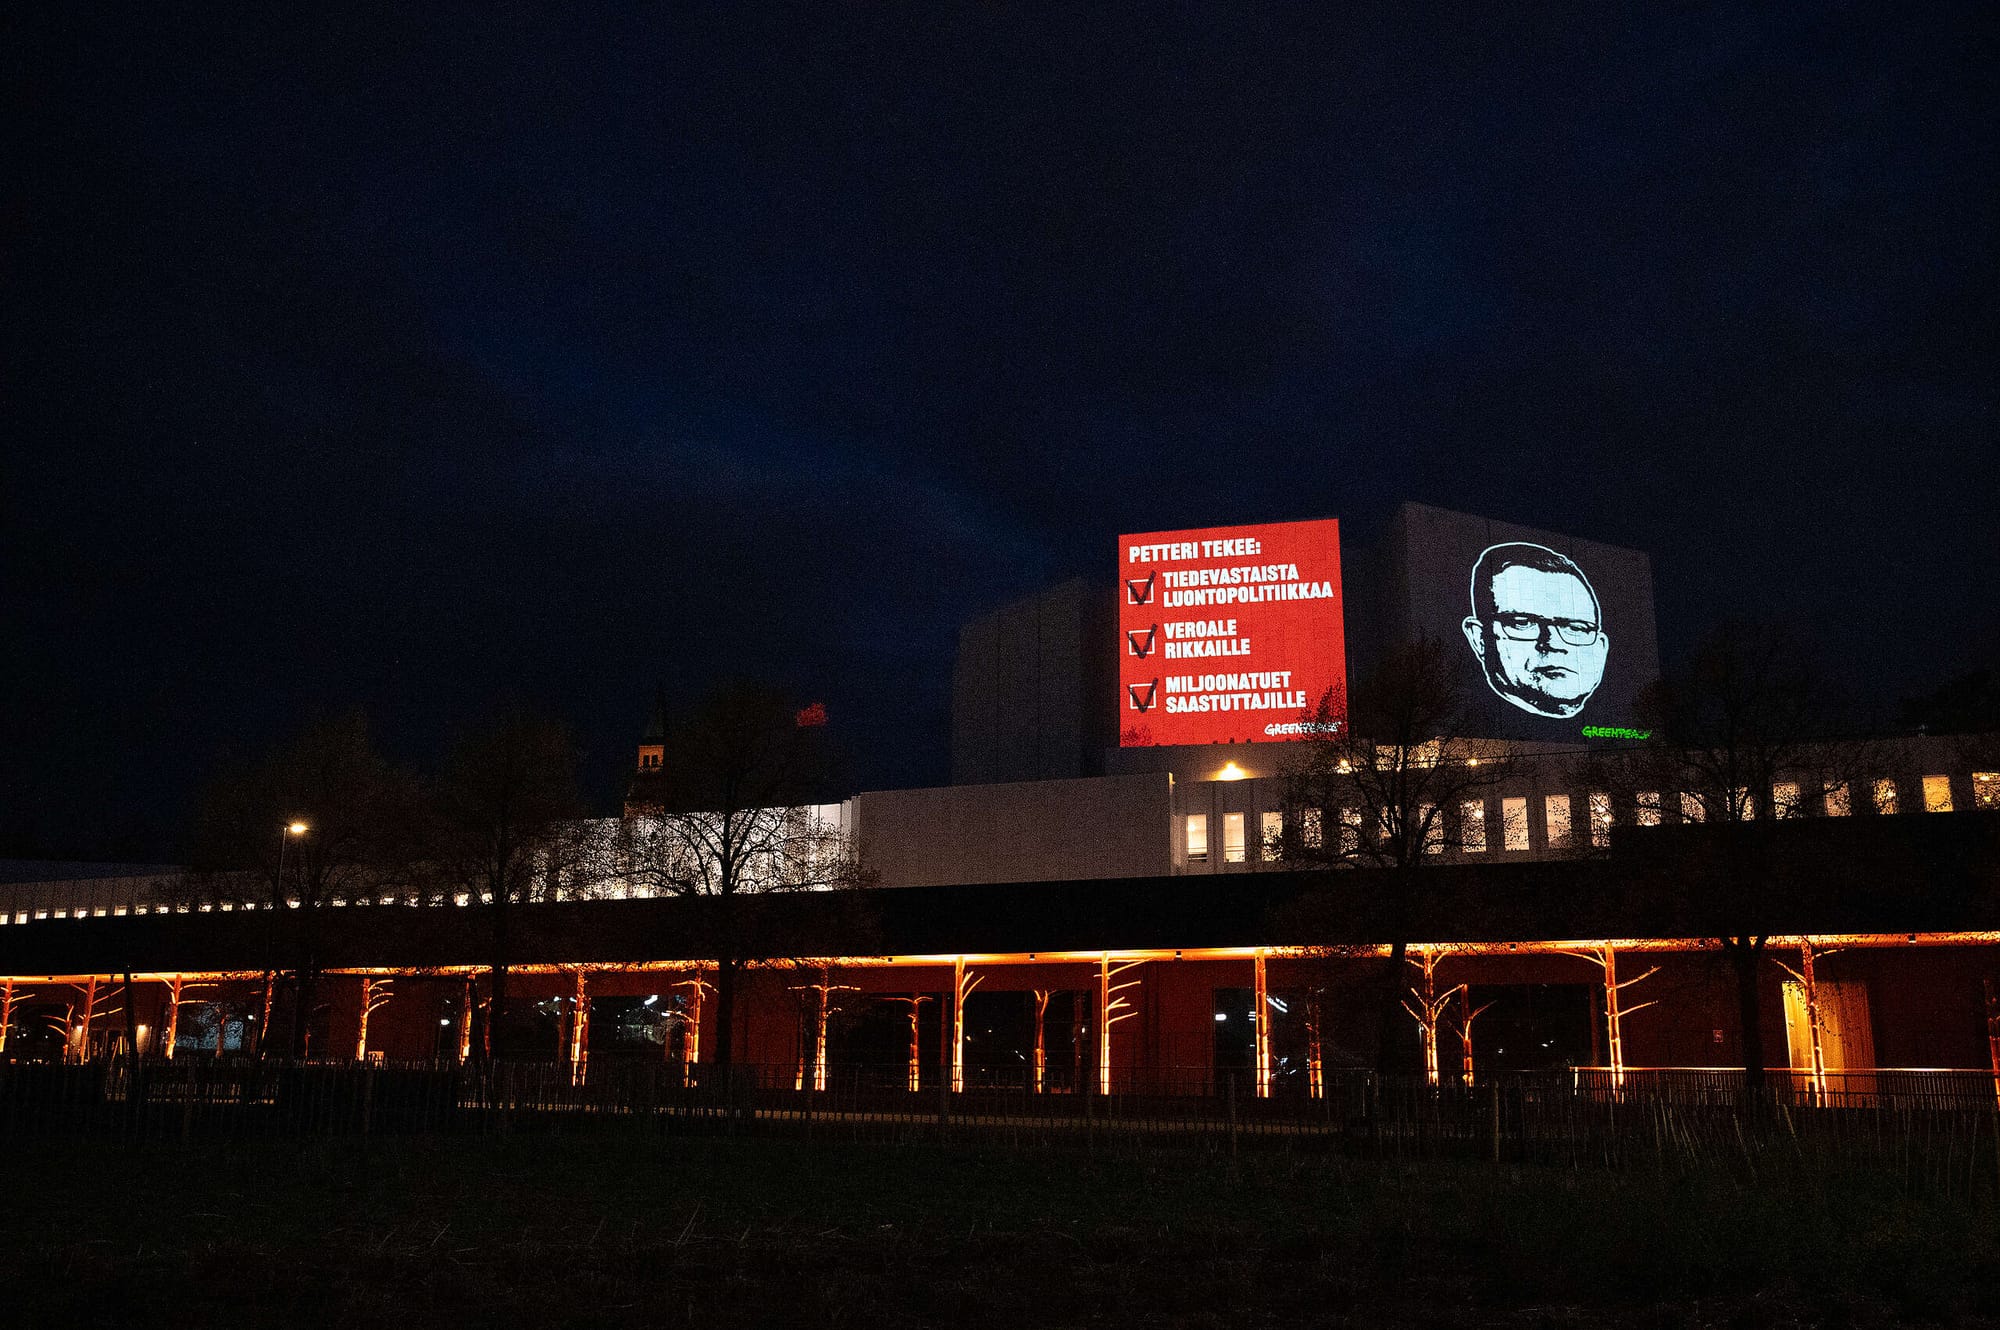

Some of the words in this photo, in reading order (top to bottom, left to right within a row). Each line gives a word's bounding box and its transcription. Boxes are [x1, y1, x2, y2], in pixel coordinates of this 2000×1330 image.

[1129, 541, 1198, 563] PETTERI
[1202, 537, 1261, 558] TEKEE:
[1162, 563, 1299, 588] TIEDEVASTAISTA
[1163, 581, 1334, 608] LUONTOPOLITIIKKAA
[1164, 619, 1237, 639] VEROALE
[1165, 638, 1250, 659] RIKKAILLE
[1165, 671, 1291, 693] MILJOONATUET
[1165, 691, 1306, 713] SAASTUTTAJILLE
[1264, 721, 1342, 736] GREENPE
